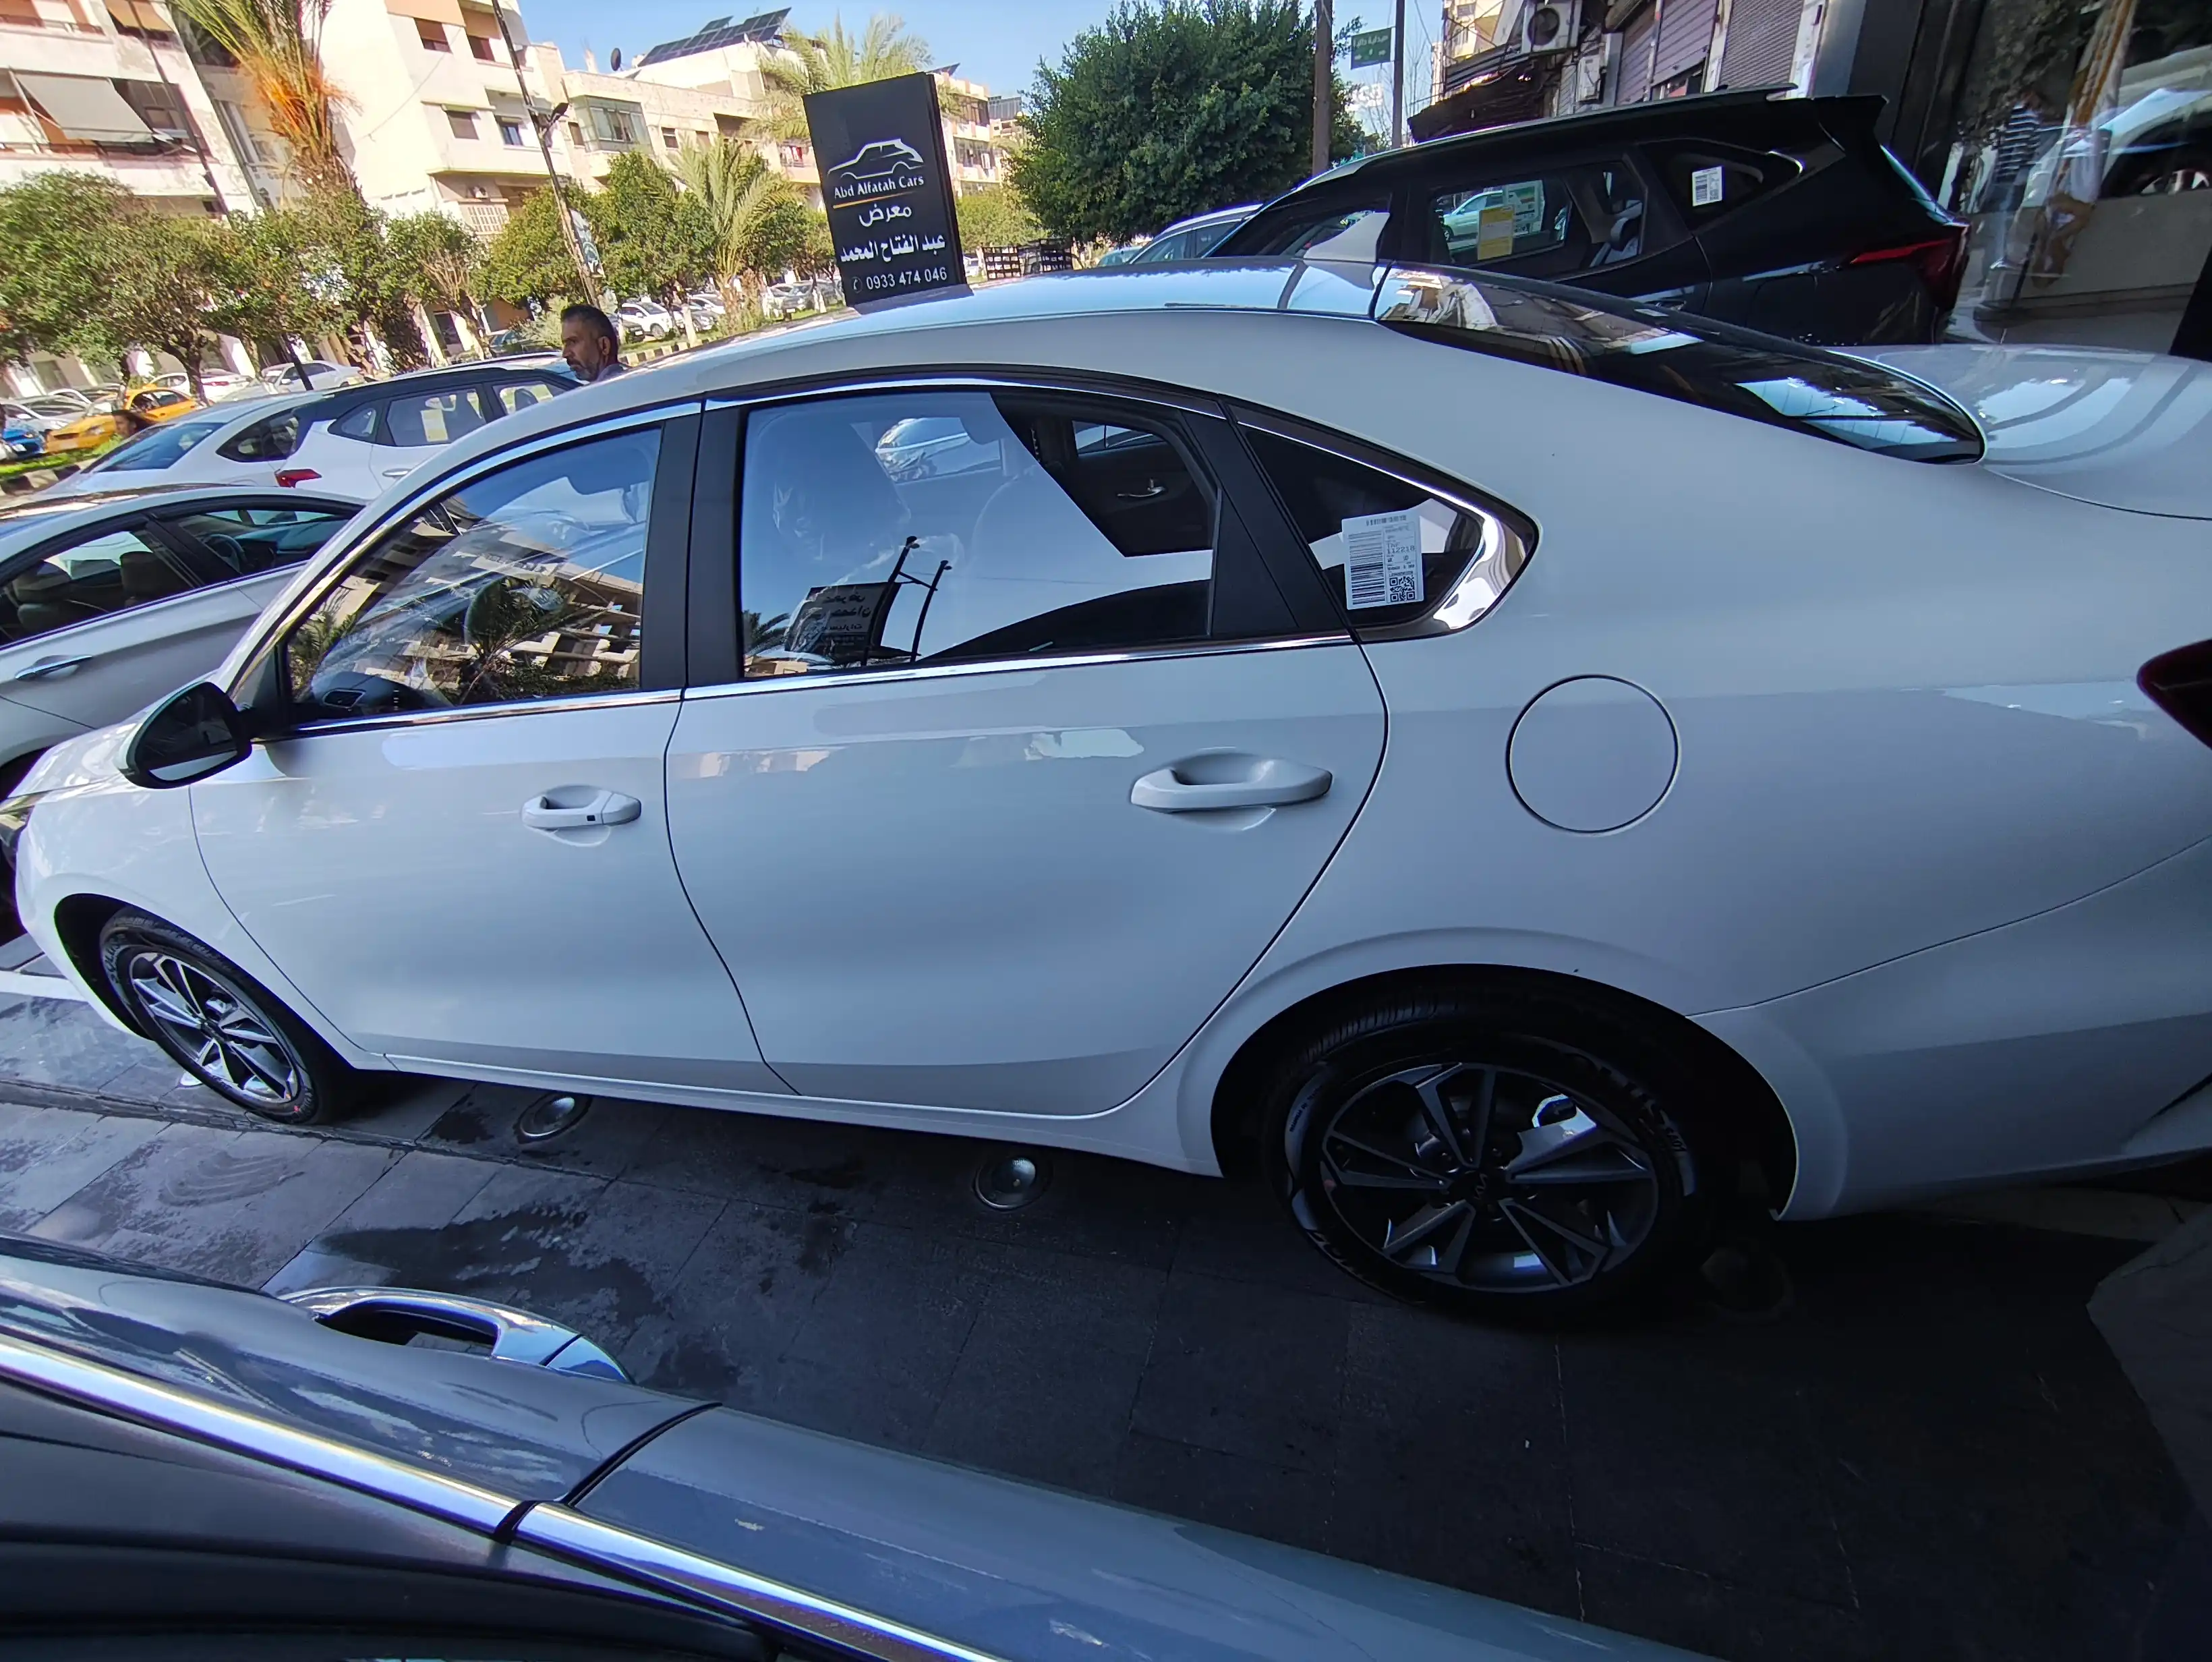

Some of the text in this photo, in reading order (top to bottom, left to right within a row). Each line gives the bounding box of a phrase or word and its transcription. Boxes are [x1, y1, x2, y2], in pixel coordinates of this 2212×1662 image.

[834, 175, 925, 199] Abd Alfatah Cars
[858, 202, 912, 227] معرض
[880, 233, 919, 262] الفتاح
[921, 233, 945, 256] عبد
[866, 266, 948, 290] 0933 474 046
